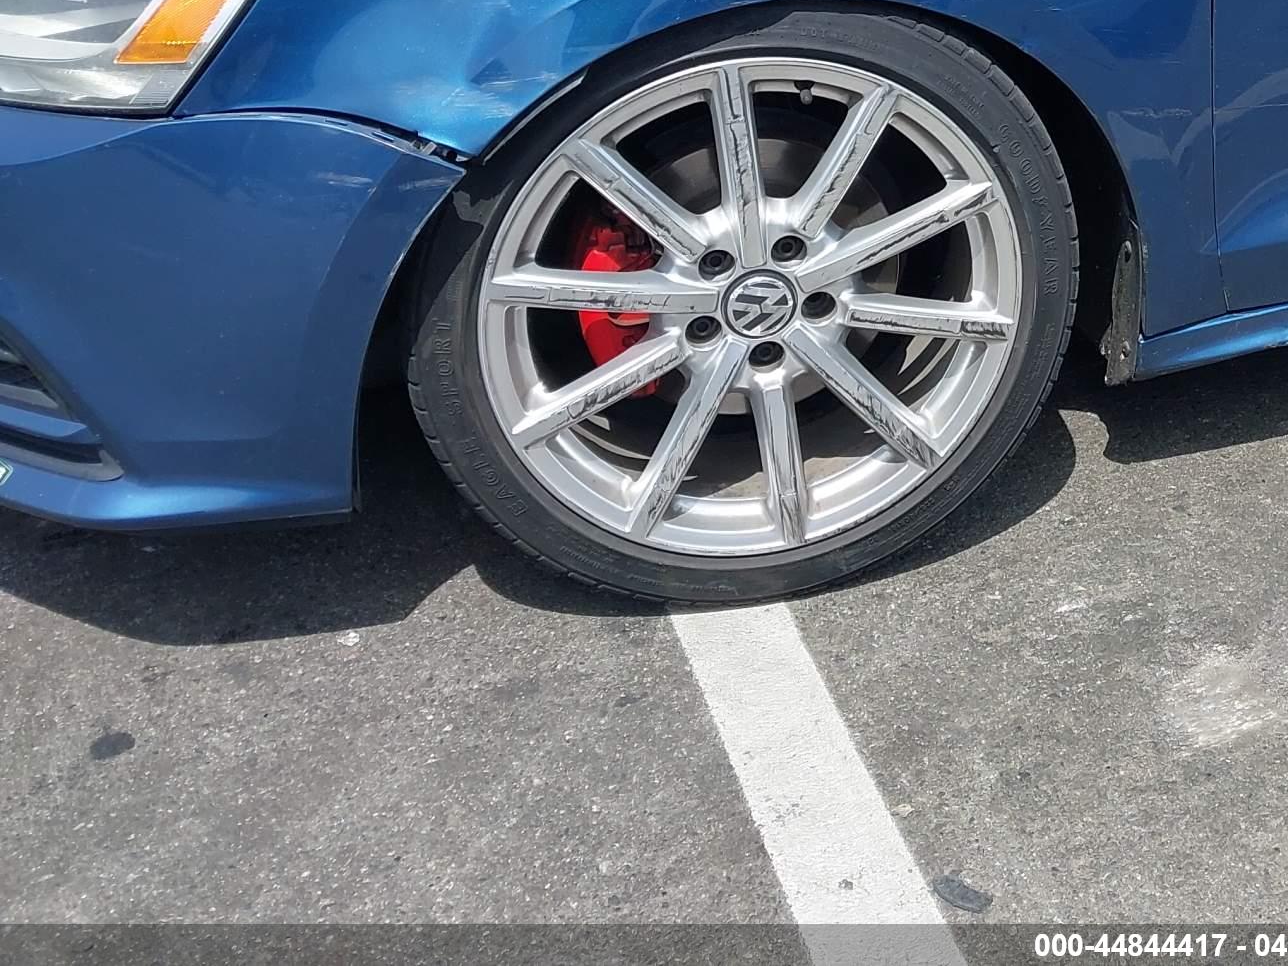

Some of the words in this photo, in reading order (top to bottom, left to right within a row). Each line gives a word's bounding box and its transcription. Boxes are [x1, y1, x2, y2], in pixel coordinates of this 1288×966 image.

[999, 123, 1059, 295] GOODYEAR
[432, 317, 463, 416] SPORT
[460, 437, 527, 517] EAGLE
